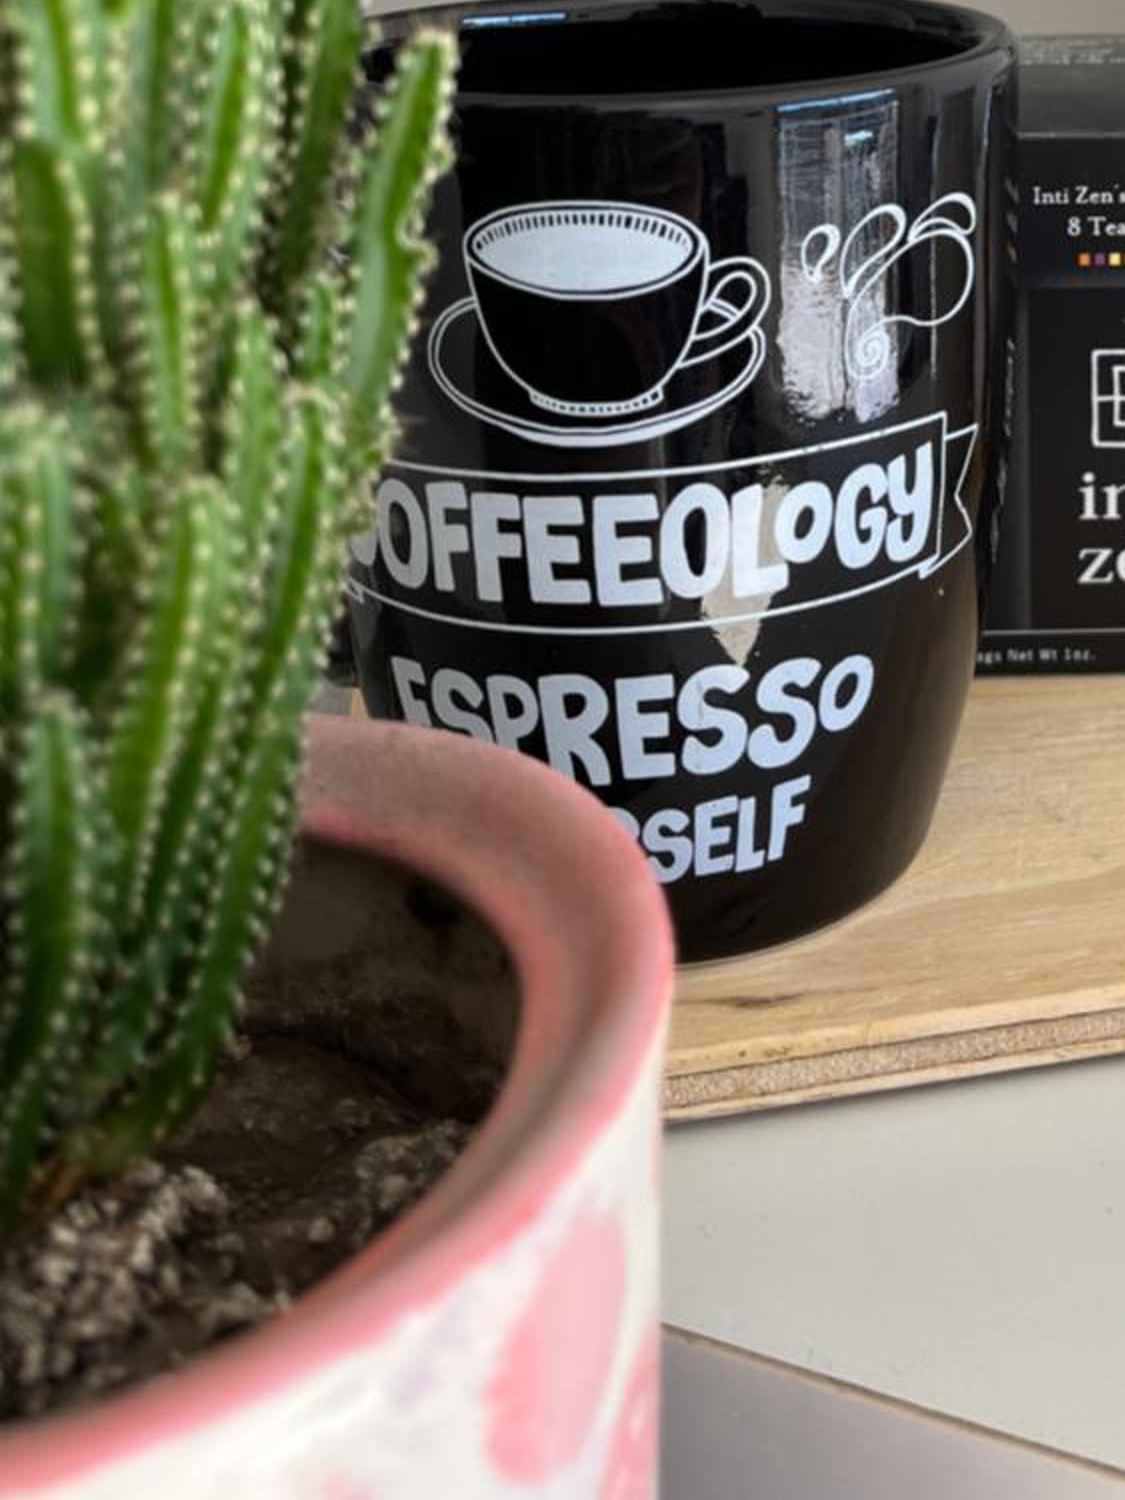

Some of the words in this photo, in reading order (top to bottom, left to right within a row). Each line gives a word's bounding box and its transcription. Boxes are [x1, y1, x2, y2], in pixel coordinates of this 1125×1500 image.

[1032, 185, 1069, 205] Inti
[1066, 216, 1082, 237] 8
[390, 653, 875, 786] ESPRESSO
